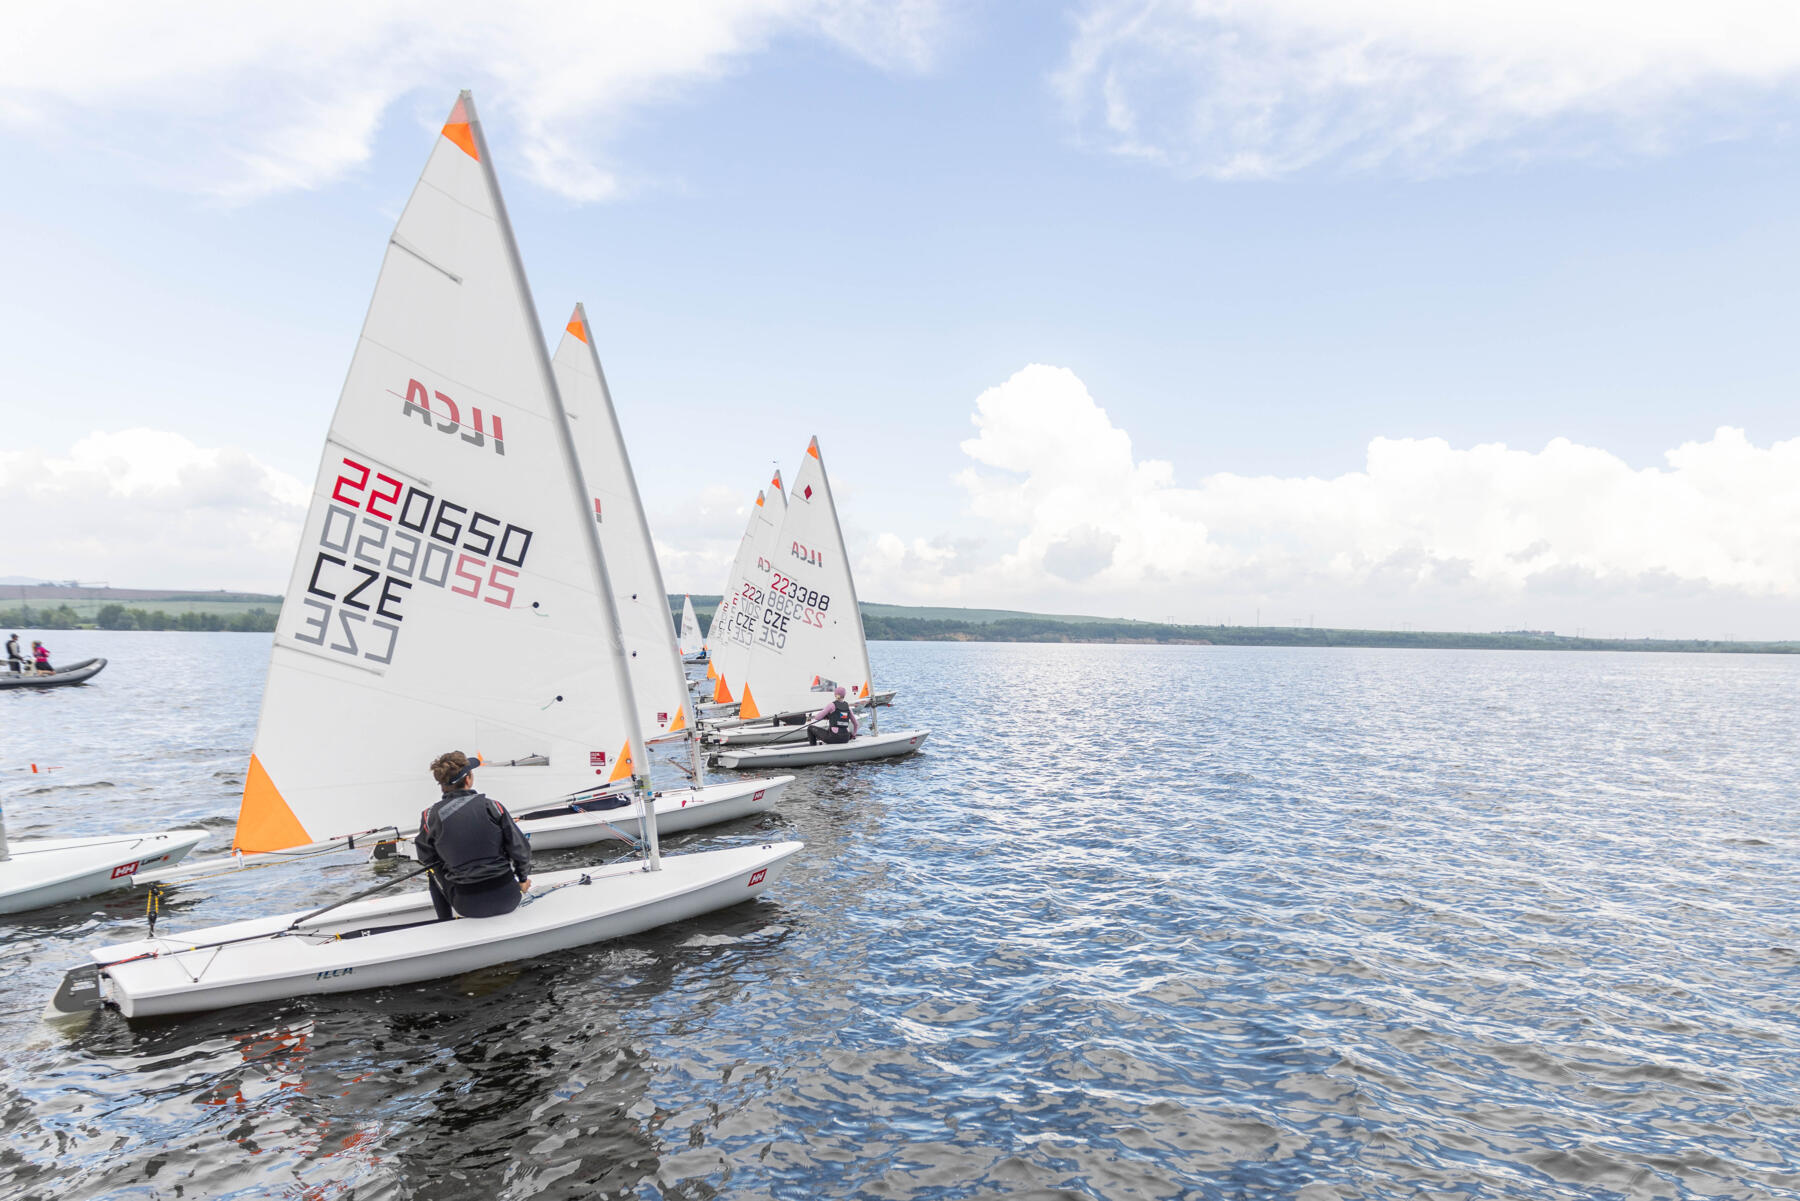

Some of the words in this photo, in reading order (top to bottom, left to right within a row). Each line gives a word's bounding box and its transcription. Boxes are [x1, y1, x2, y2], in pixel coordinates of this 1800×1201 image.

[332, 457, 533, 568] 220650
[307, 552, 413, 622] CZE
[771, 573, 830, 612] 223388
[736, 611, 757, 632] CZE
[763, 608, 790, 633] CZE
